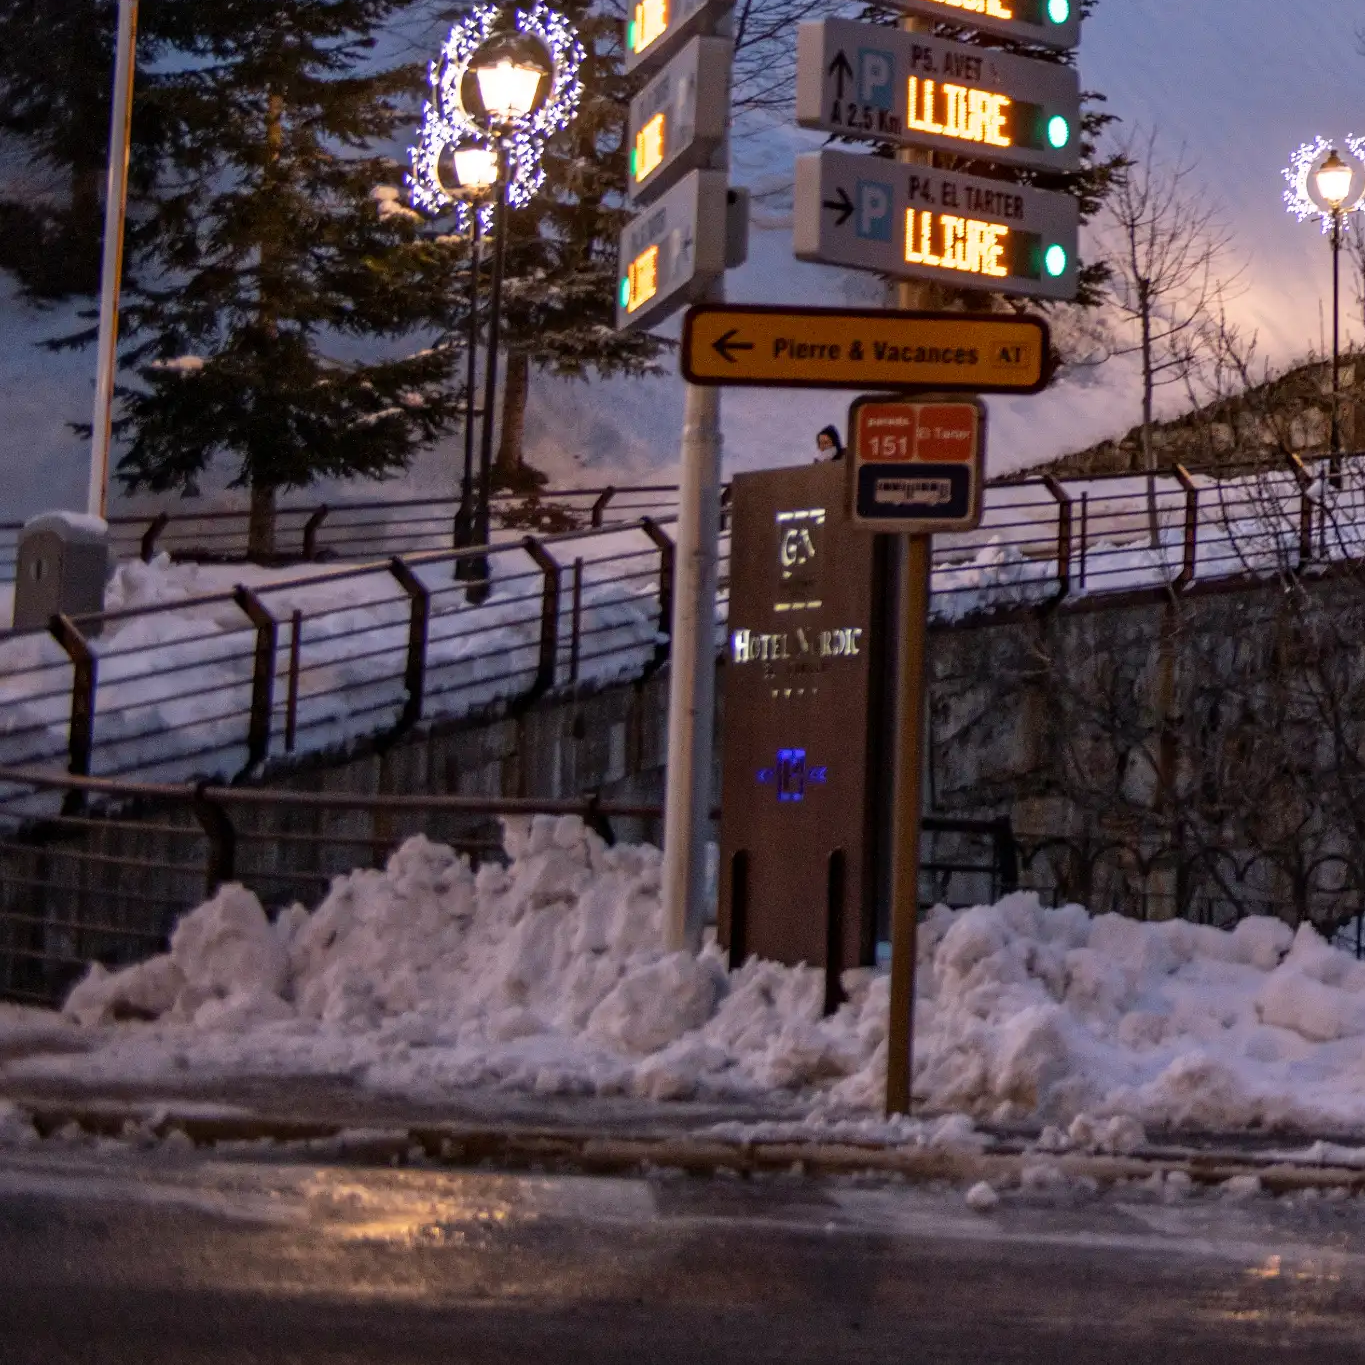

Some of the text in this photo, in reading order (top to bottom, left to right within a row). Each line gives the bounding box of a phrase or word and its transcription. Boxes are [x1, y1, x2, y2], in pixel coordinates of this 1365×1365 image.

[943, 51, 983, 82] AVET
[940, 182, 960, 208] EL
[964, 185, 1025, 220] TARTER
[772, 337, 842, 362] Pierre
[850, 340, 864, 362] &
[873, 340, 979, 365] Vacances
[867, 435, 909, 456] 151
